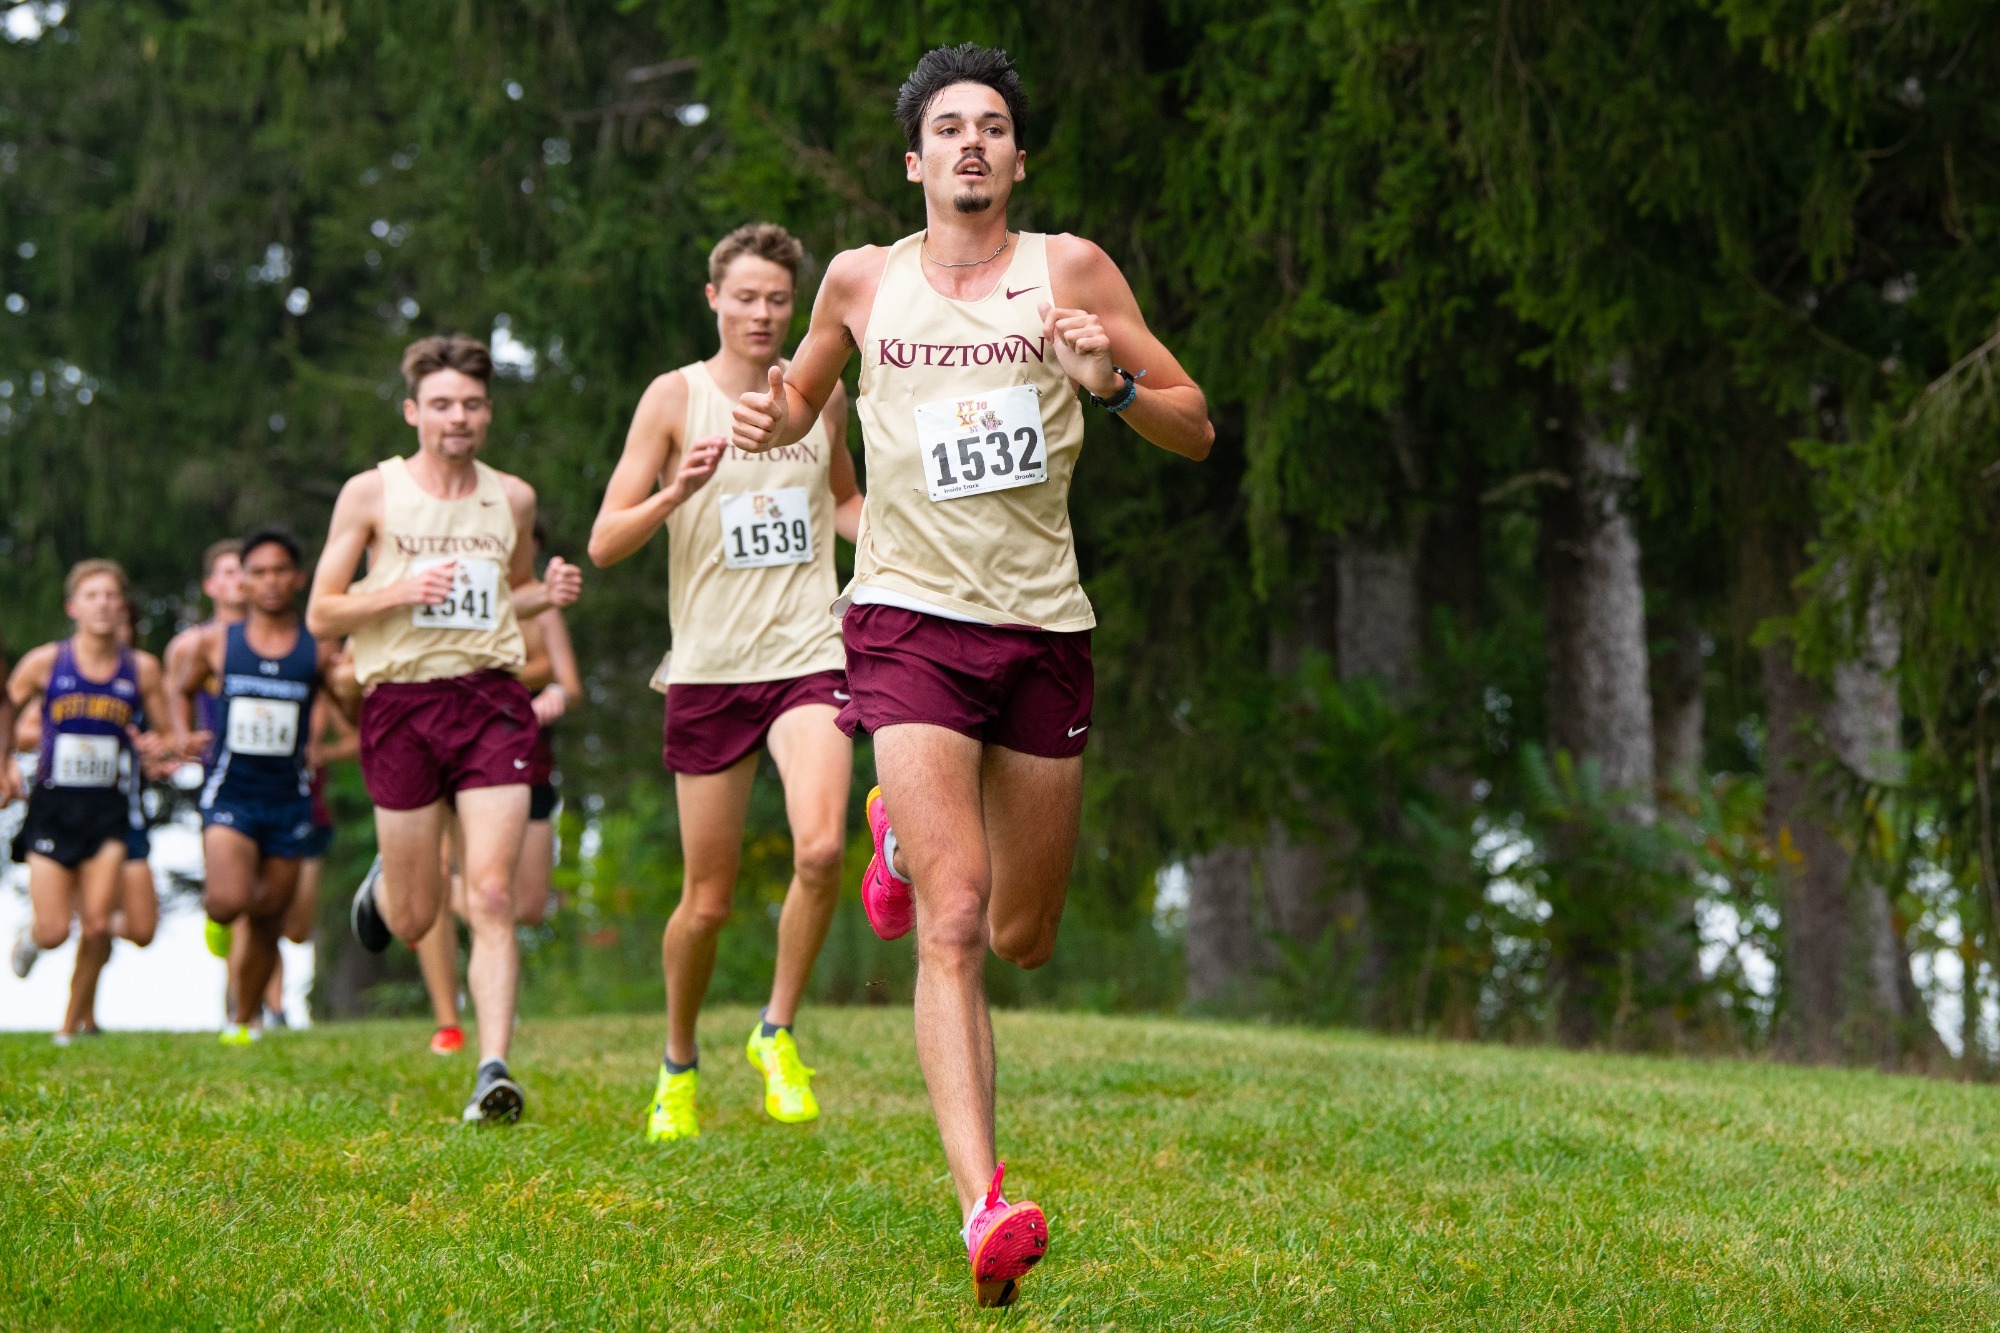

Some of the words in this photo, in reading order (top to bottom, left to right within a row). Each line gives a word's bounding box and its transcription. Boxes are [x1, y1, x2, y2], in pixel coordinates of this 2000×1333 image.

[878, 335, 1045, 368] KUTZTOWN
[932, 426, 1042, 487] 1532
[944, 486, 961, 494] Inside
[395, 533, 508, 556] KUTZTOWN
[731, 519, 807, 557] 1539
